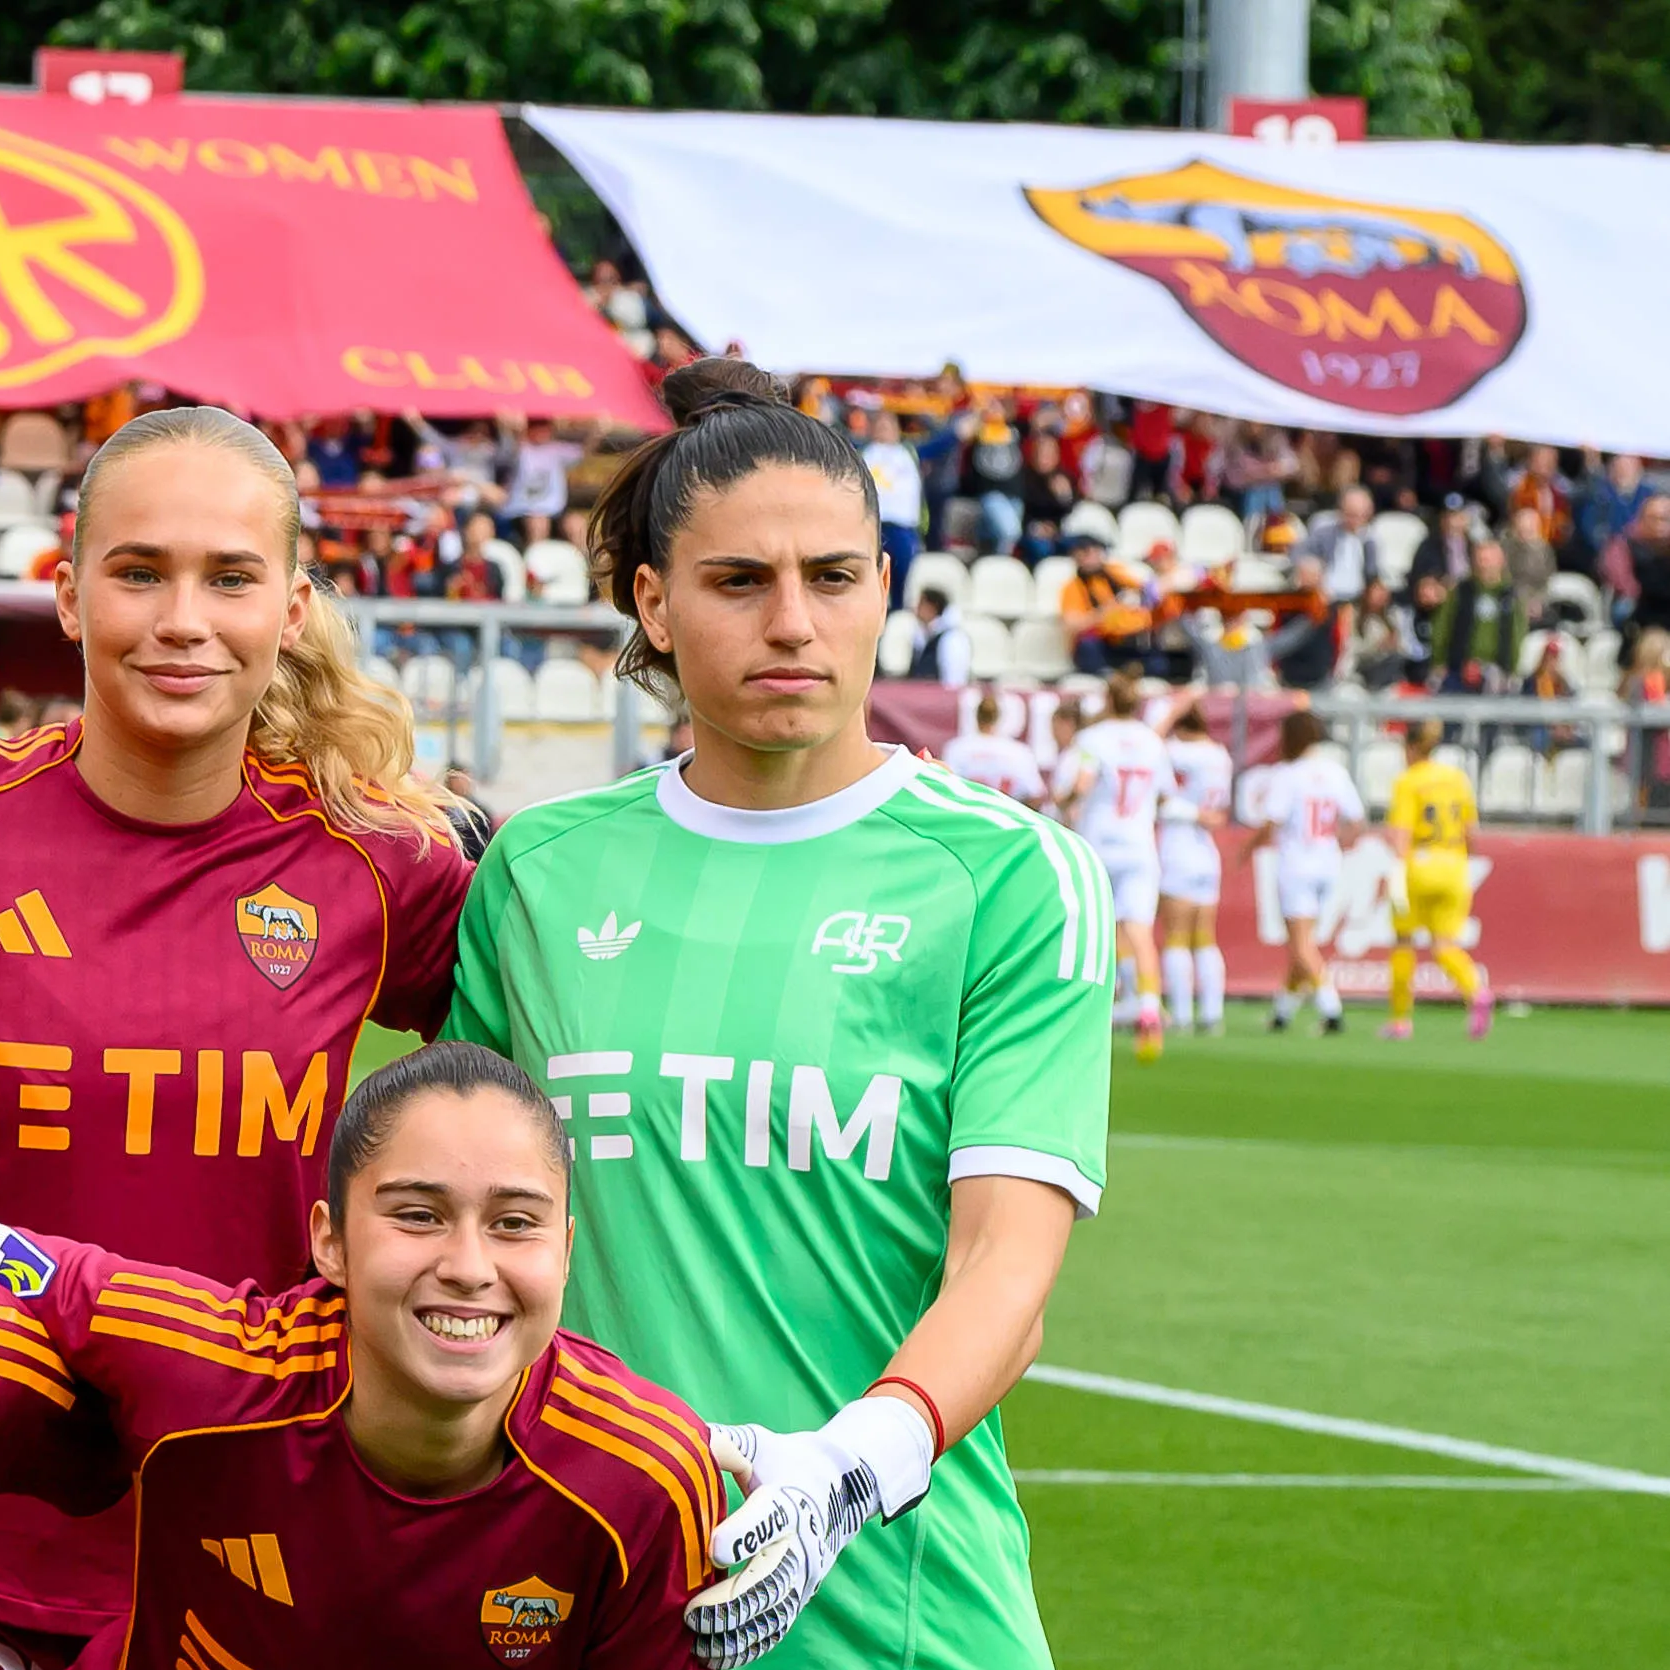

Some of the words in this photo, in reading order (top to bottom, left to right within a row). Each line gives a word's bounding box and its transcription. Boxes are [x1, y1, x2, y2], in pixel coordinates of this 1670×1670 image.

[104, 136, 479, 203] WOMEN
[1171, 258, 1500, 346] ROMA
[342, 346, 594, 399] CLUB
[1300, 348, 1423, 389] 1927
[250, 942, 309, 962] ROMA
[268, 963, 292, 975] 1927
[103, 1048, 328, 1157] TIM
[659, 1052, 902, 1181] TIM
[732, 1499, 790, 1562] reusch
[489, 1629, 551, 1646] ROMA
[505, 1647, 531, 1659] 1927
